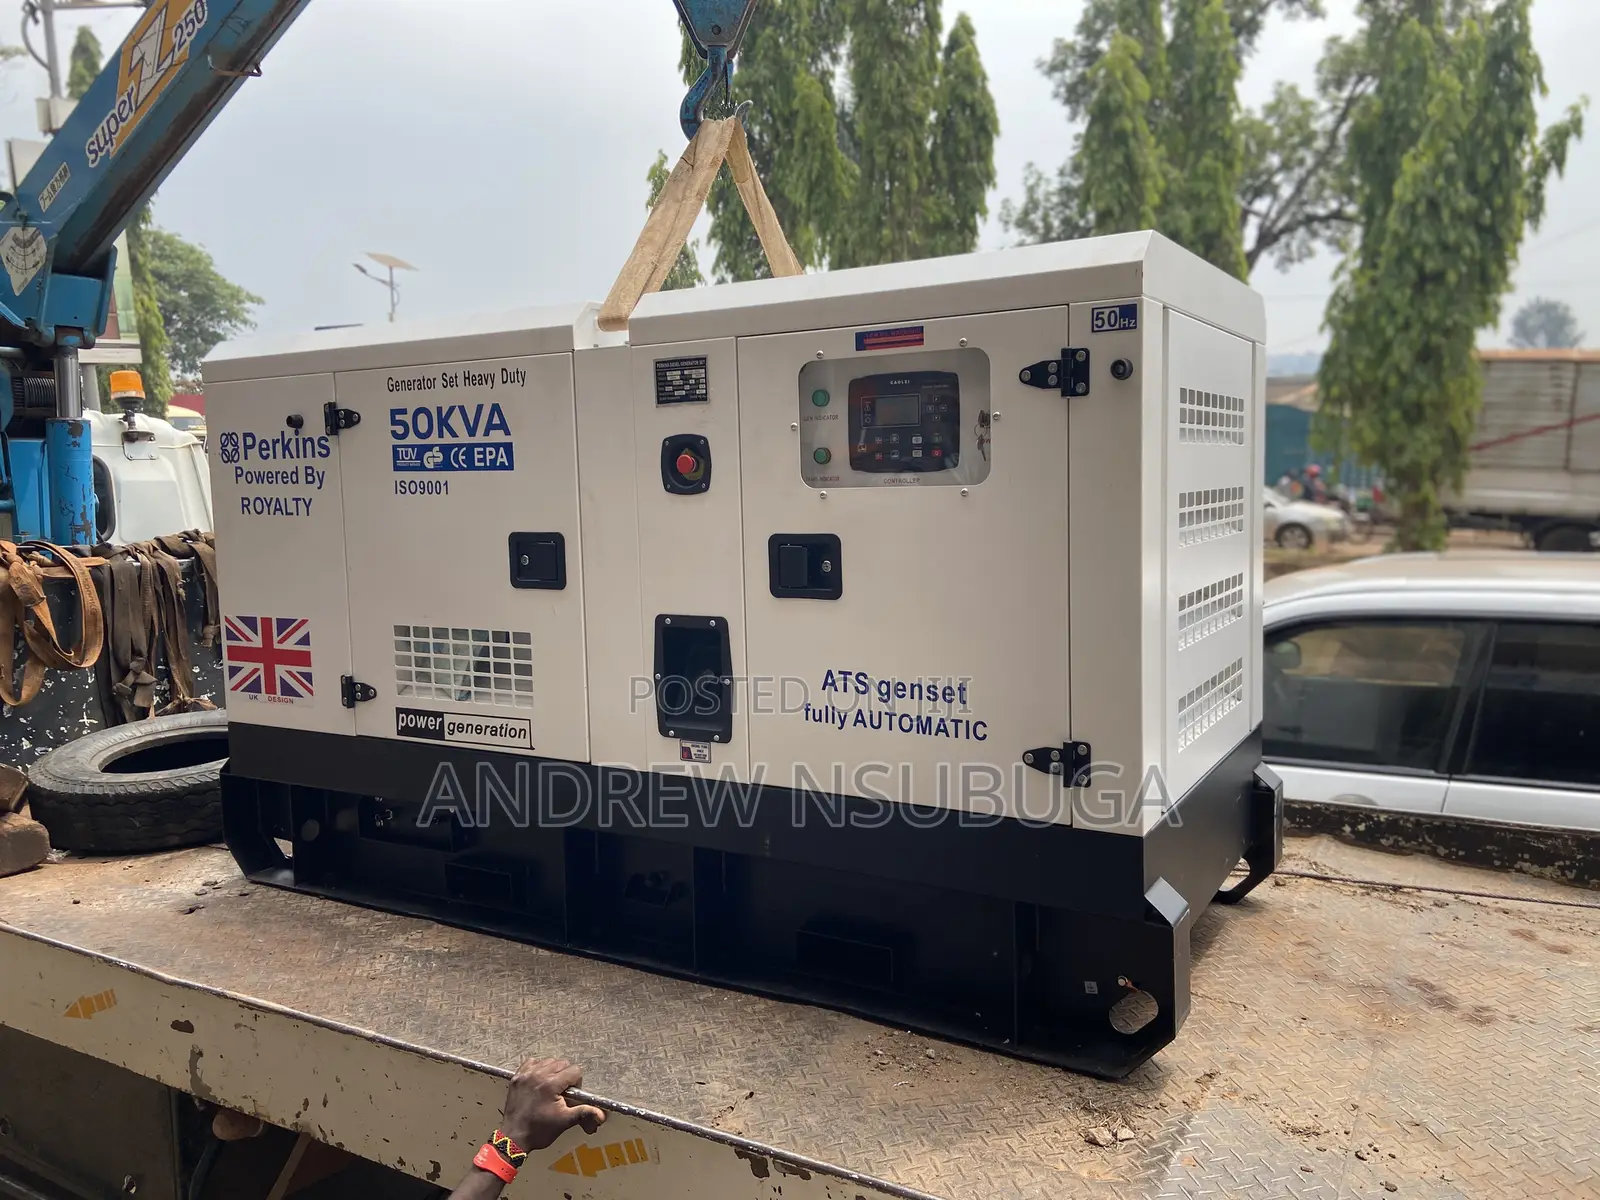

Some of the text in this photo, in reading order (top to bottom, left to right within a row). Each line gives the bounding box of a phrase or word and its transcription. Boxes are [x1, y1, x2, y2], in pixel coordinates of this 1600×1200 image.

[87, 86, 134, 165] super
[173, 0, 206, 53] 250
[387, 367, 526, 393] Generator Set Heavy Duty
[389, 403, 512, 441] 50KVA
[242, 431, 331, 461] Perkins
[474, 447, 509, 467] EPA
[234, 466, 326, 489] Powered By
[394, 480, 449, 495] ISO9001
[240, 497, 313, 516] ROYALTY
[267, 695, 294, 704] DESIGN
[821, 669, 967, 704] ATS genset
[399, 713, 527, 740] power generation
[804, 703, 988, 741] fully AUTOMATIC
